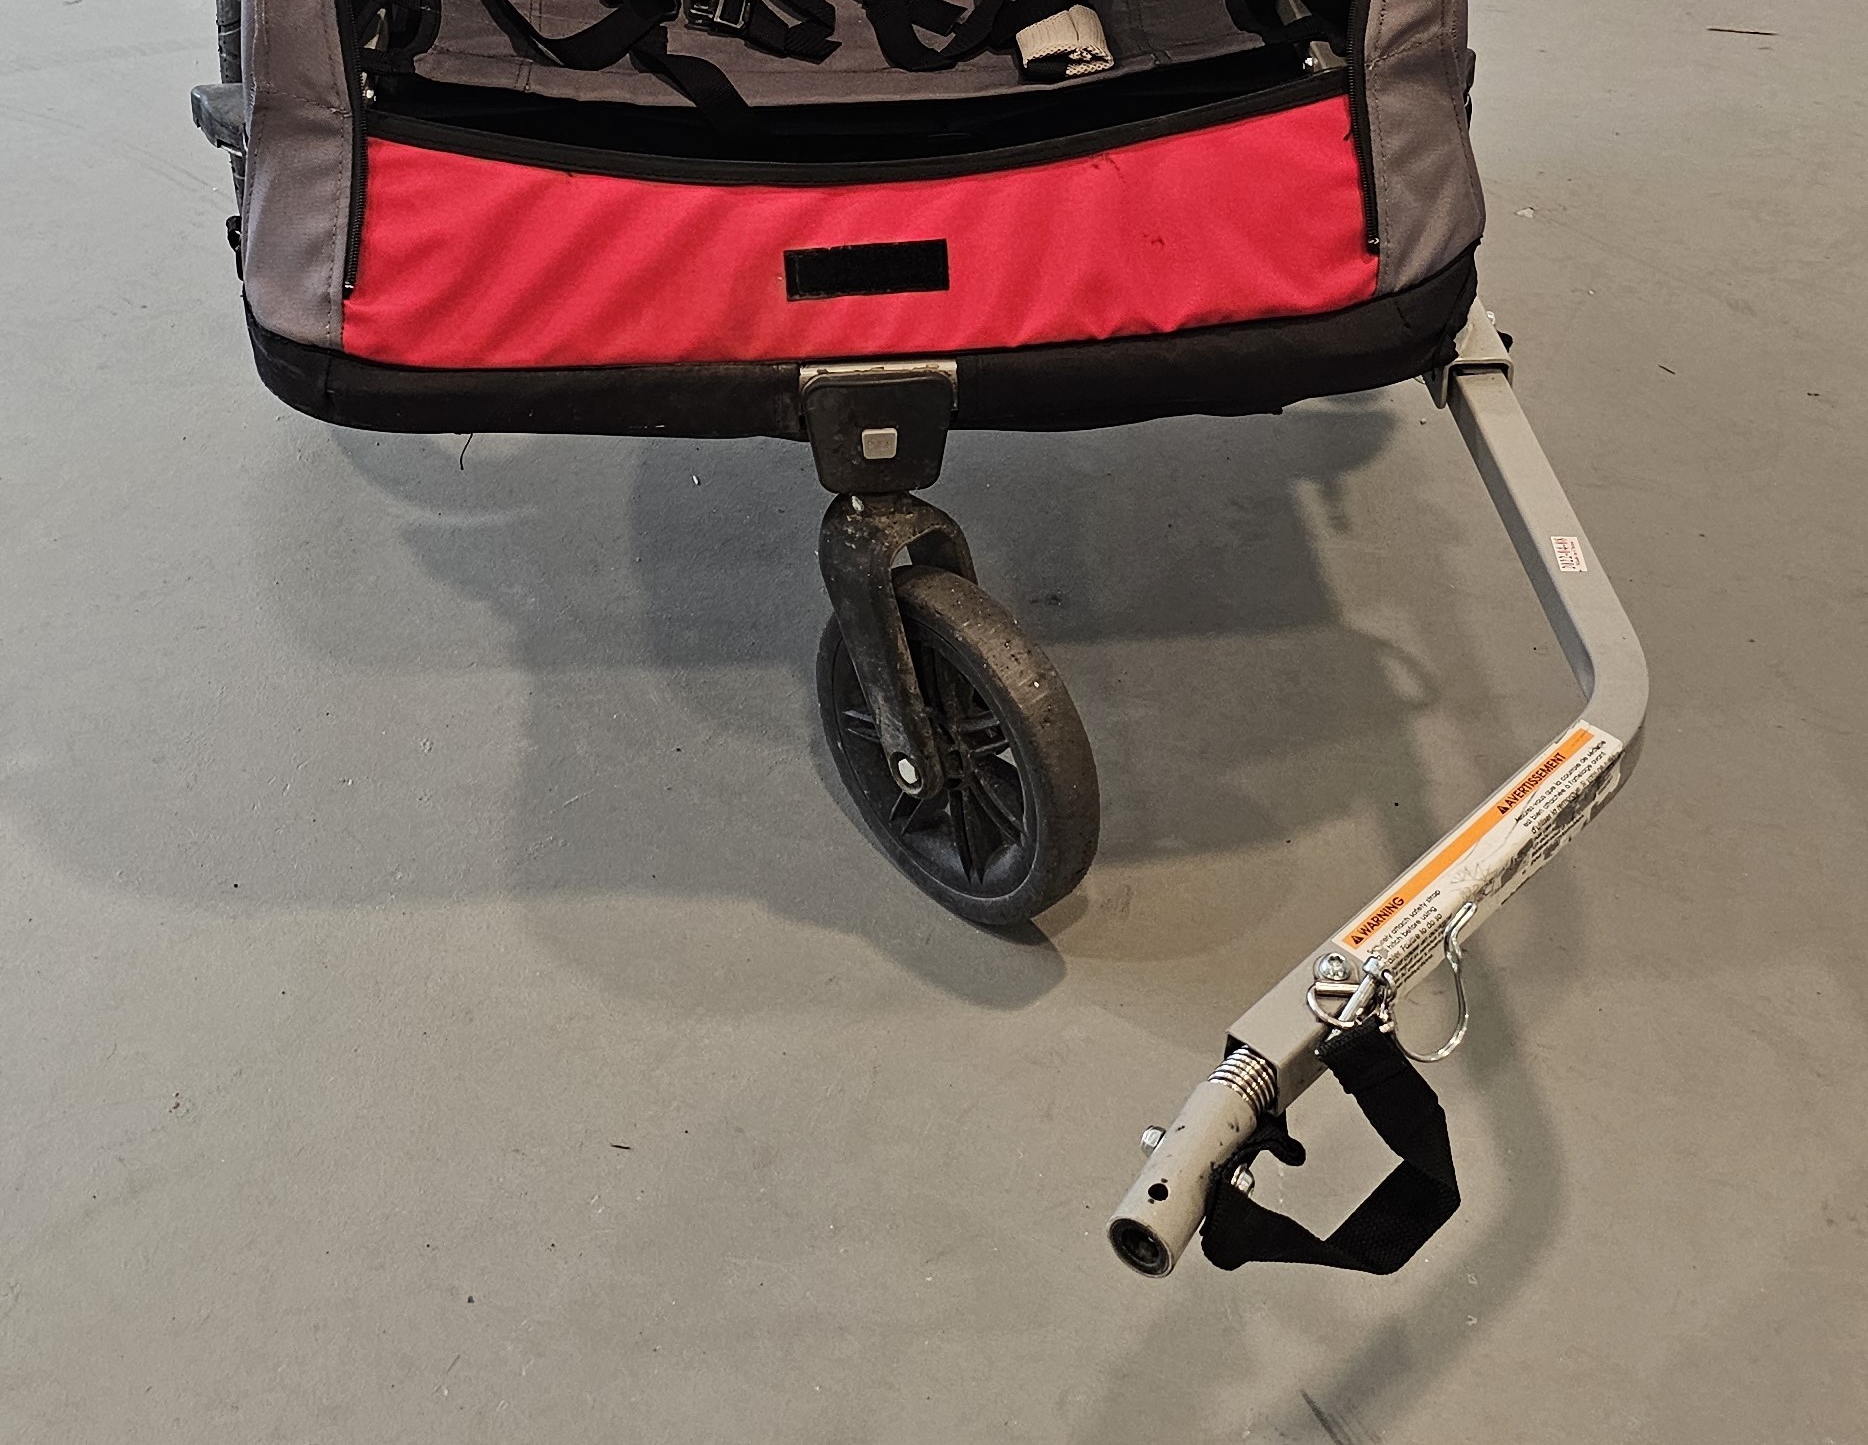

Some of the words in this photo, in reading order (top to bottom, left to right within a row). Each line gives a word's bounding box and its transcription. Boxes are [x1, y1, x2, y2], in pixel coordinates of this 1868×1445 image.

[1504, 752, 1566, 808] AVERTISSEMENT
[1359, 896, 1405, 937] WARNING
[1387, 933, 1406, 950] hitch
[1404, 919, 1421, 936] before
[1421, 905, 1438, 921] using
[1391, 917, 1411, 935] attach
[1409, 901, 1428, 919] safety
[1426, 889, 1441, 904] strap
